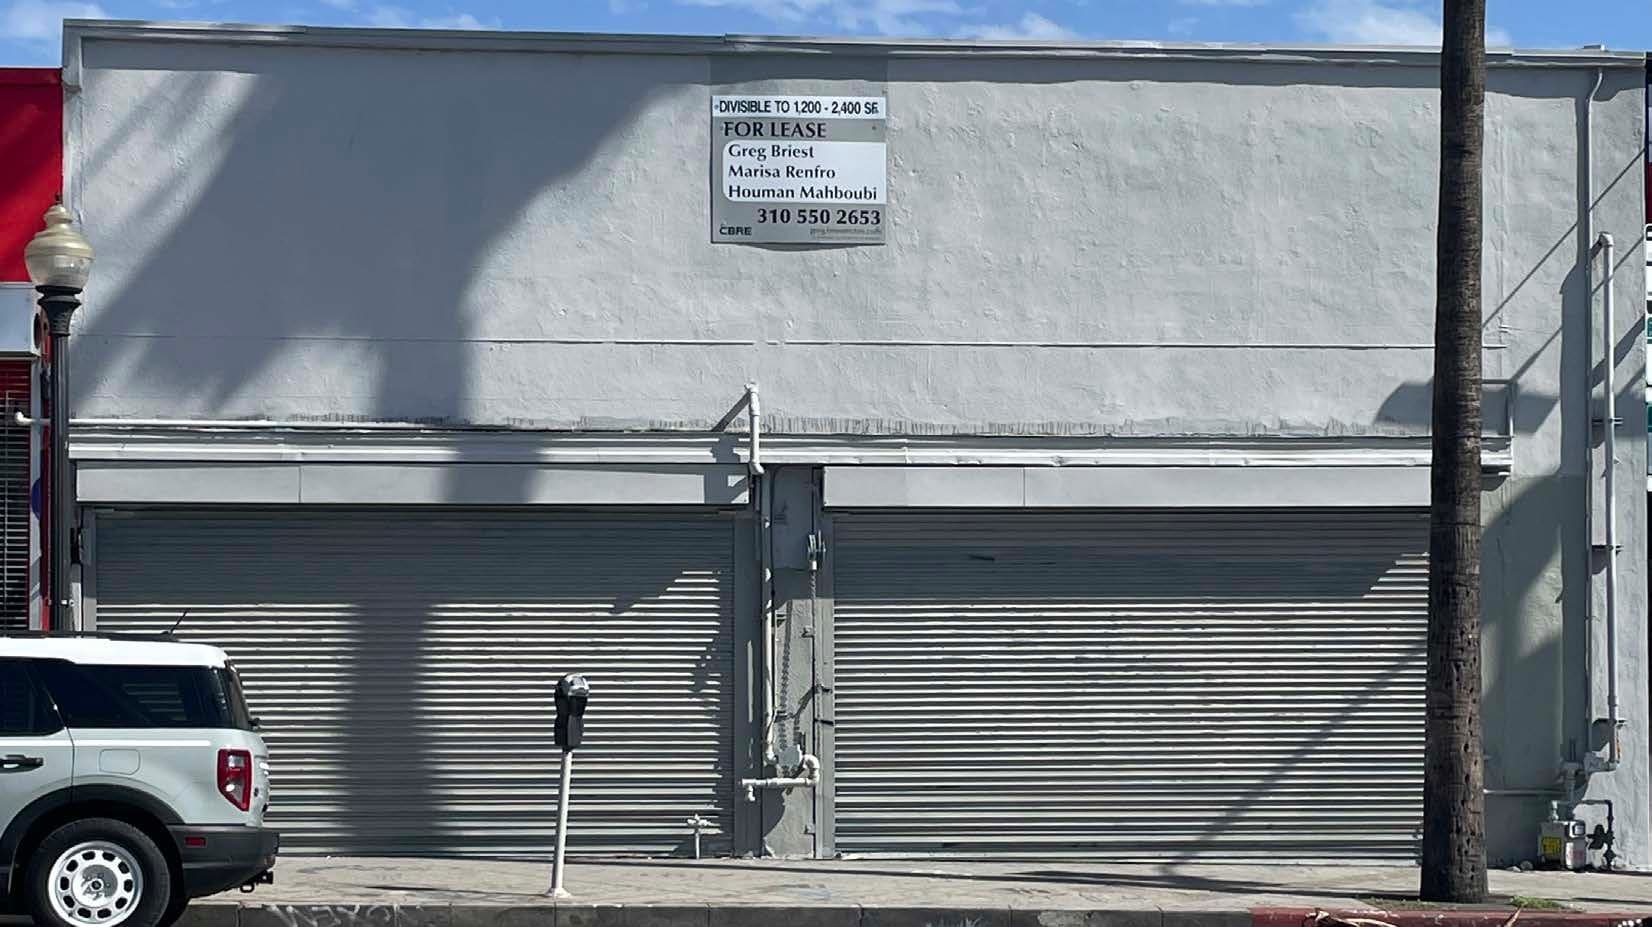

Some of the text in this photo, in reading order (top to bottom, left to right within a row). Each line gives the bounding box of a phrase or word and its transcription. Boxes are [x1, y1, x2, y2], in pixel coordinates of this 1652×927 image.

[719, 100, 771, 113] DIVISIBLE
[774, 100, 790, 113] TO
[794, 100, 821, 114] 1,200
[831, 101, 861, 116] 2,400
[723, 121, 827, 138] FOR LEASE
[728, 144, 814, 161] Greg Briest
[728, 165, 836, 179] Marisa Renfro
[728, 185, 877, 200] Houman Mahboubi
[757, 208, 881, 225] 310 550 2653
[719, 226, 752, 236] CBRE
